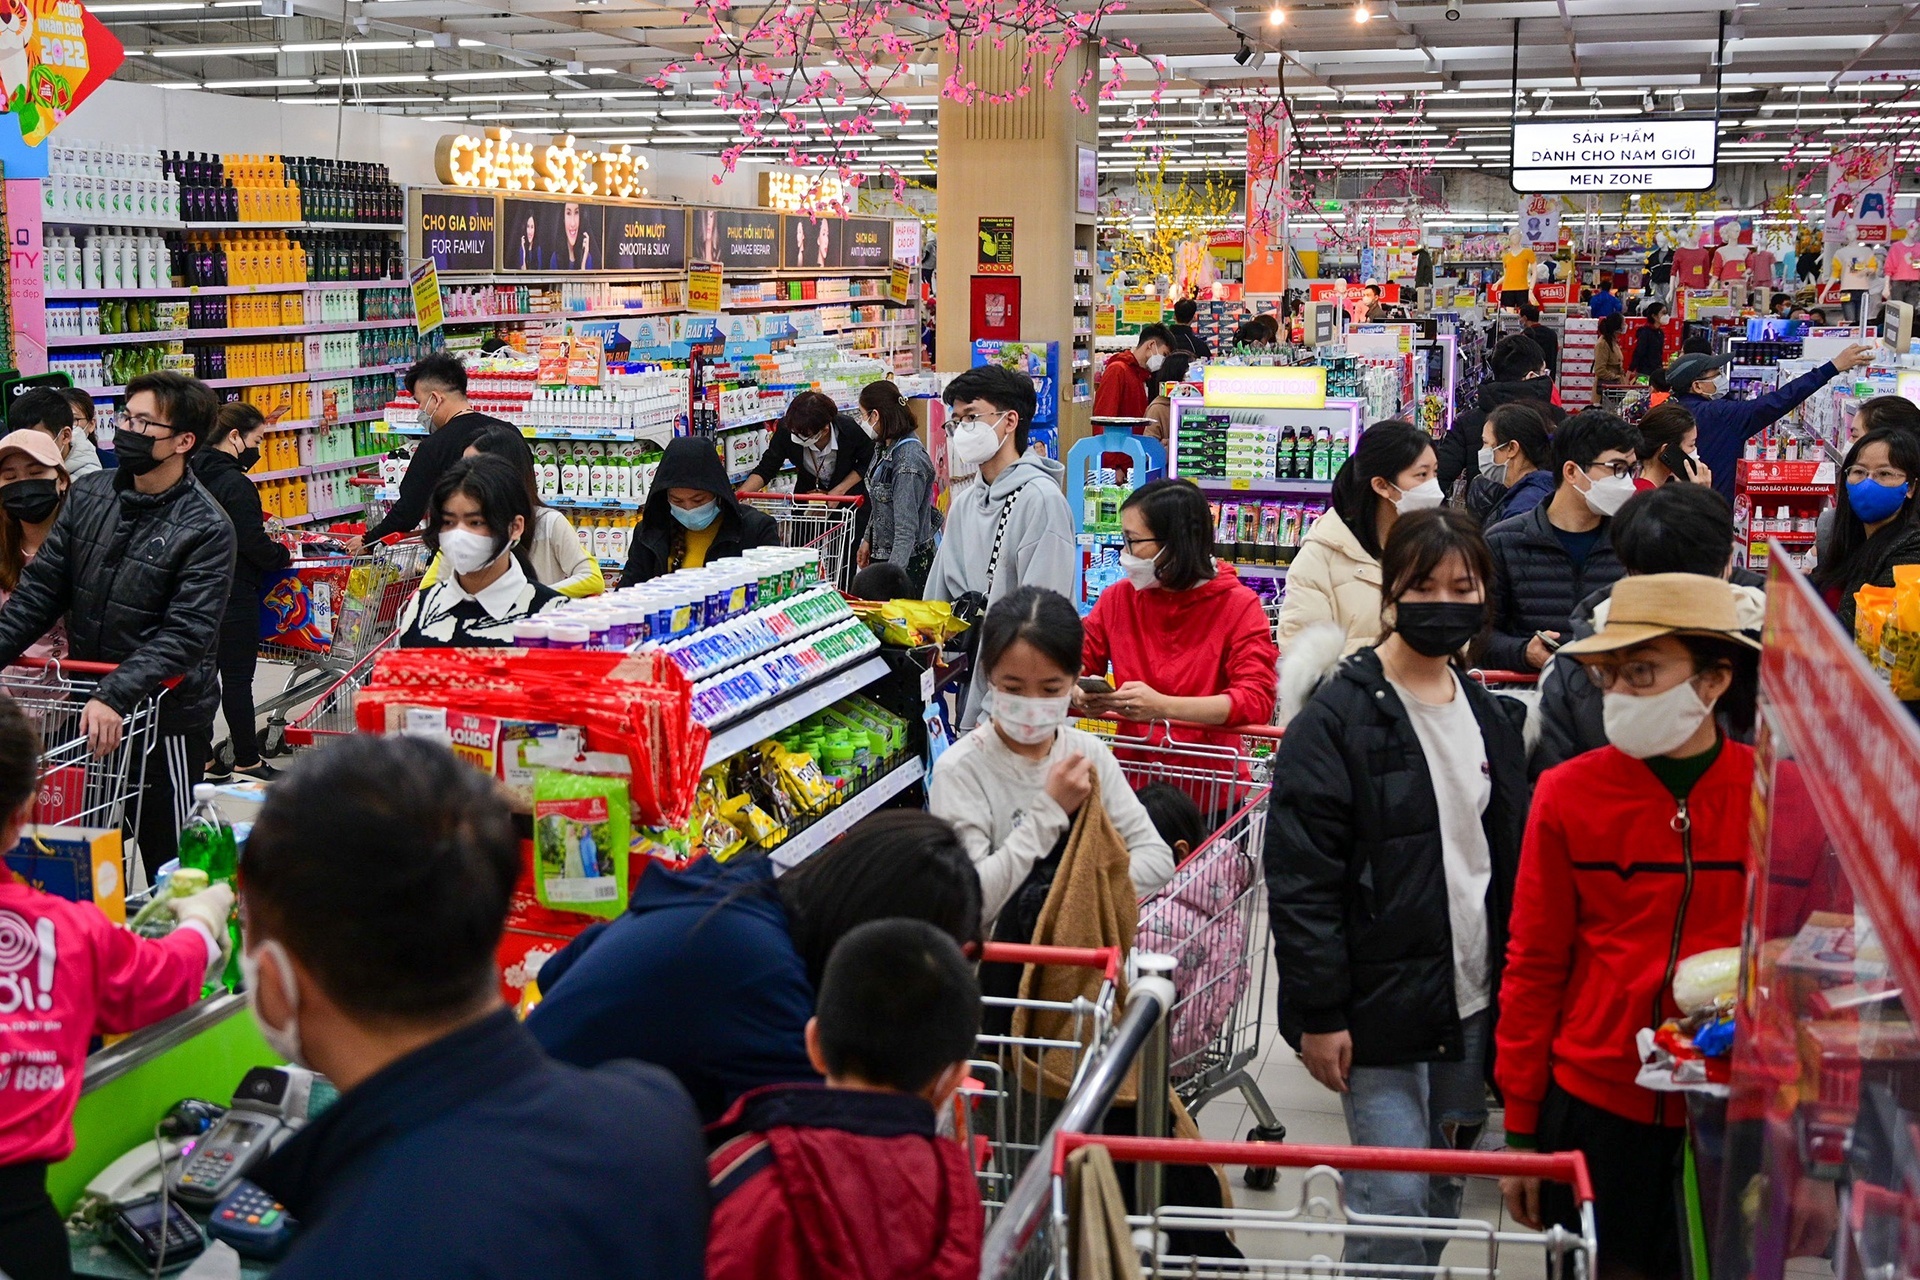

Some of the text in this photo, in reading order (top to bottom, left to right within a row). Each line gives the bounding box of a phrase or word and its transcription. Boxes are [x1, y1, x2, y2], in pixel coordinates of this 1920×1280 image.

[41, 36, 87, 68] 2022
[1573, 127, 1655, 144] SẢN PHẨM
[1531, 146, 1696, 162] DÀNH CHO NAM GIỚI
[1570, 173, 1653, 186] MEN ZONE
[422, 211, 494, 232] CHO GIA ĐÌNH
[624, 220, 667, 241] SUÔN MƯỢT
[431, 239, 485, 255] FOR FAMILY
[619, 243, 671, 256] SMOOTH & SILKY
[730, 243, 771, 256] DAMAGE REPAIR
[1207, 379, 1317, 395] PROMOTION
[462, 713, 480, 730] TÚI
[447, 726, 492, 749] LOHAS
